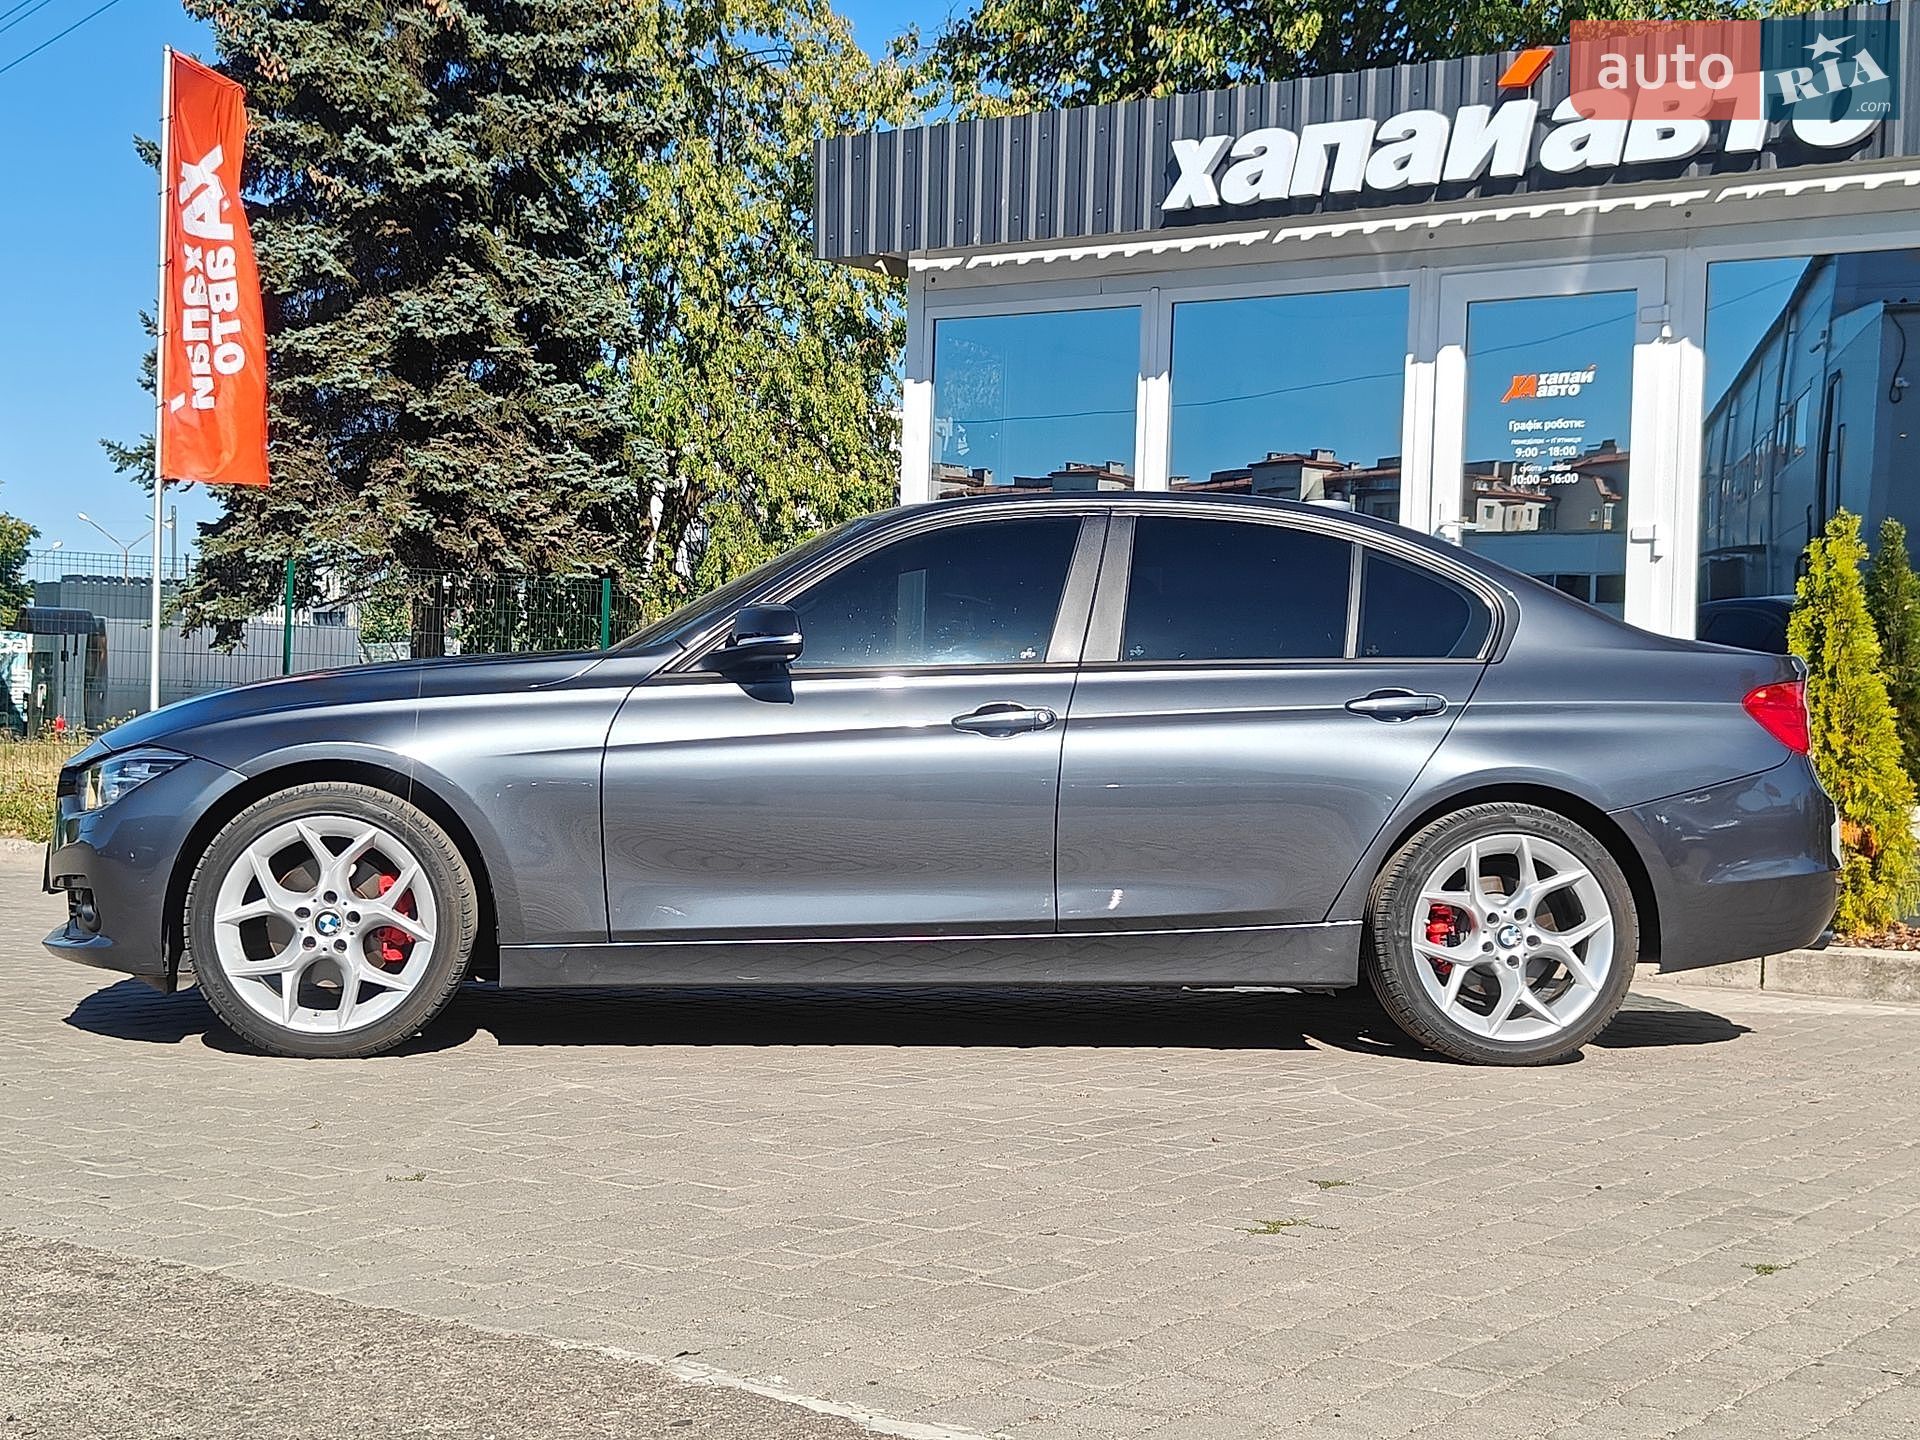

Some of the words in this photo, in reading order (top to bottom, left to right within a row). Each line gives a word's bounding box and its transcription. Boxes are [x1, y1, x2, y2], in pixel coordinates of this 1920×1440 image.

[1161, 48, 1555, 210] хапай
[1539, 64, 1884, 174] авто
[1538, 364, 1597, 386] хапай
[1536, 384, 1581, 398] авто
[1509, 420, 1543, 433] Графік
[1515, 446, 1539, 458] 9:00
[1549, 446, 1576, 457] 18:00
[1513, 474, 1540, 486] 10:00
[1550, 473, 1578, 485] 16:00
